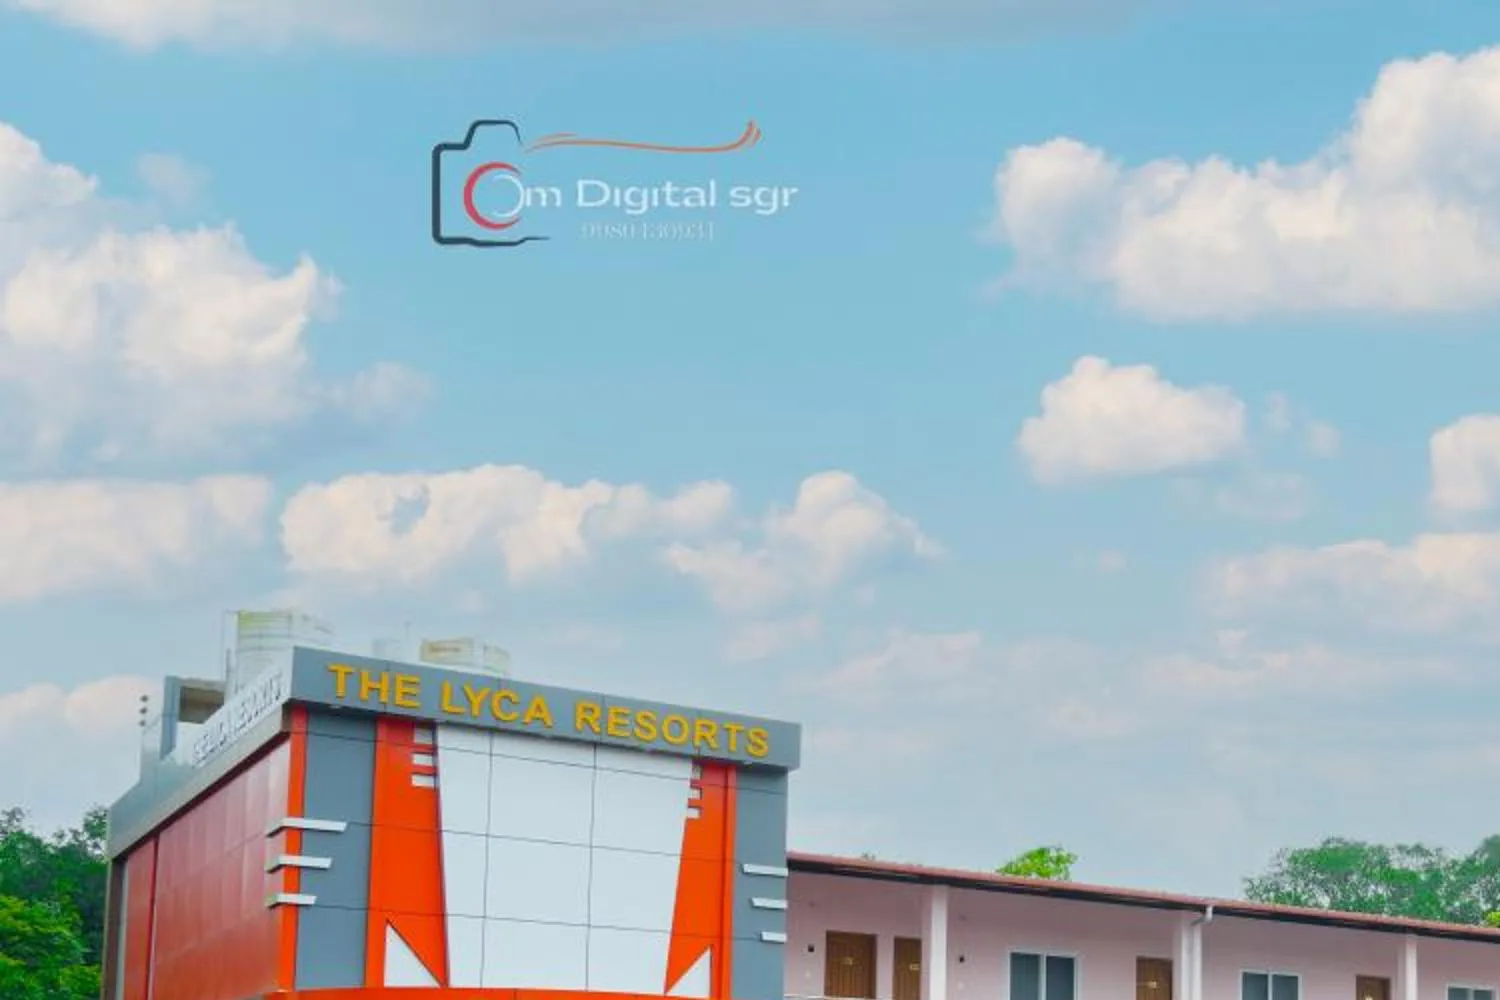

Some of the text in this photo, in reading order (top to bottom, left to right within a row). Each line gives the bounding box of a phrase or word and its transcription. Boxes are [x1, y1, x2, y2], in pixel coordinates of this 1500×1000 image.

[328, 664, 770, 759] THE LYCA RESORTS
